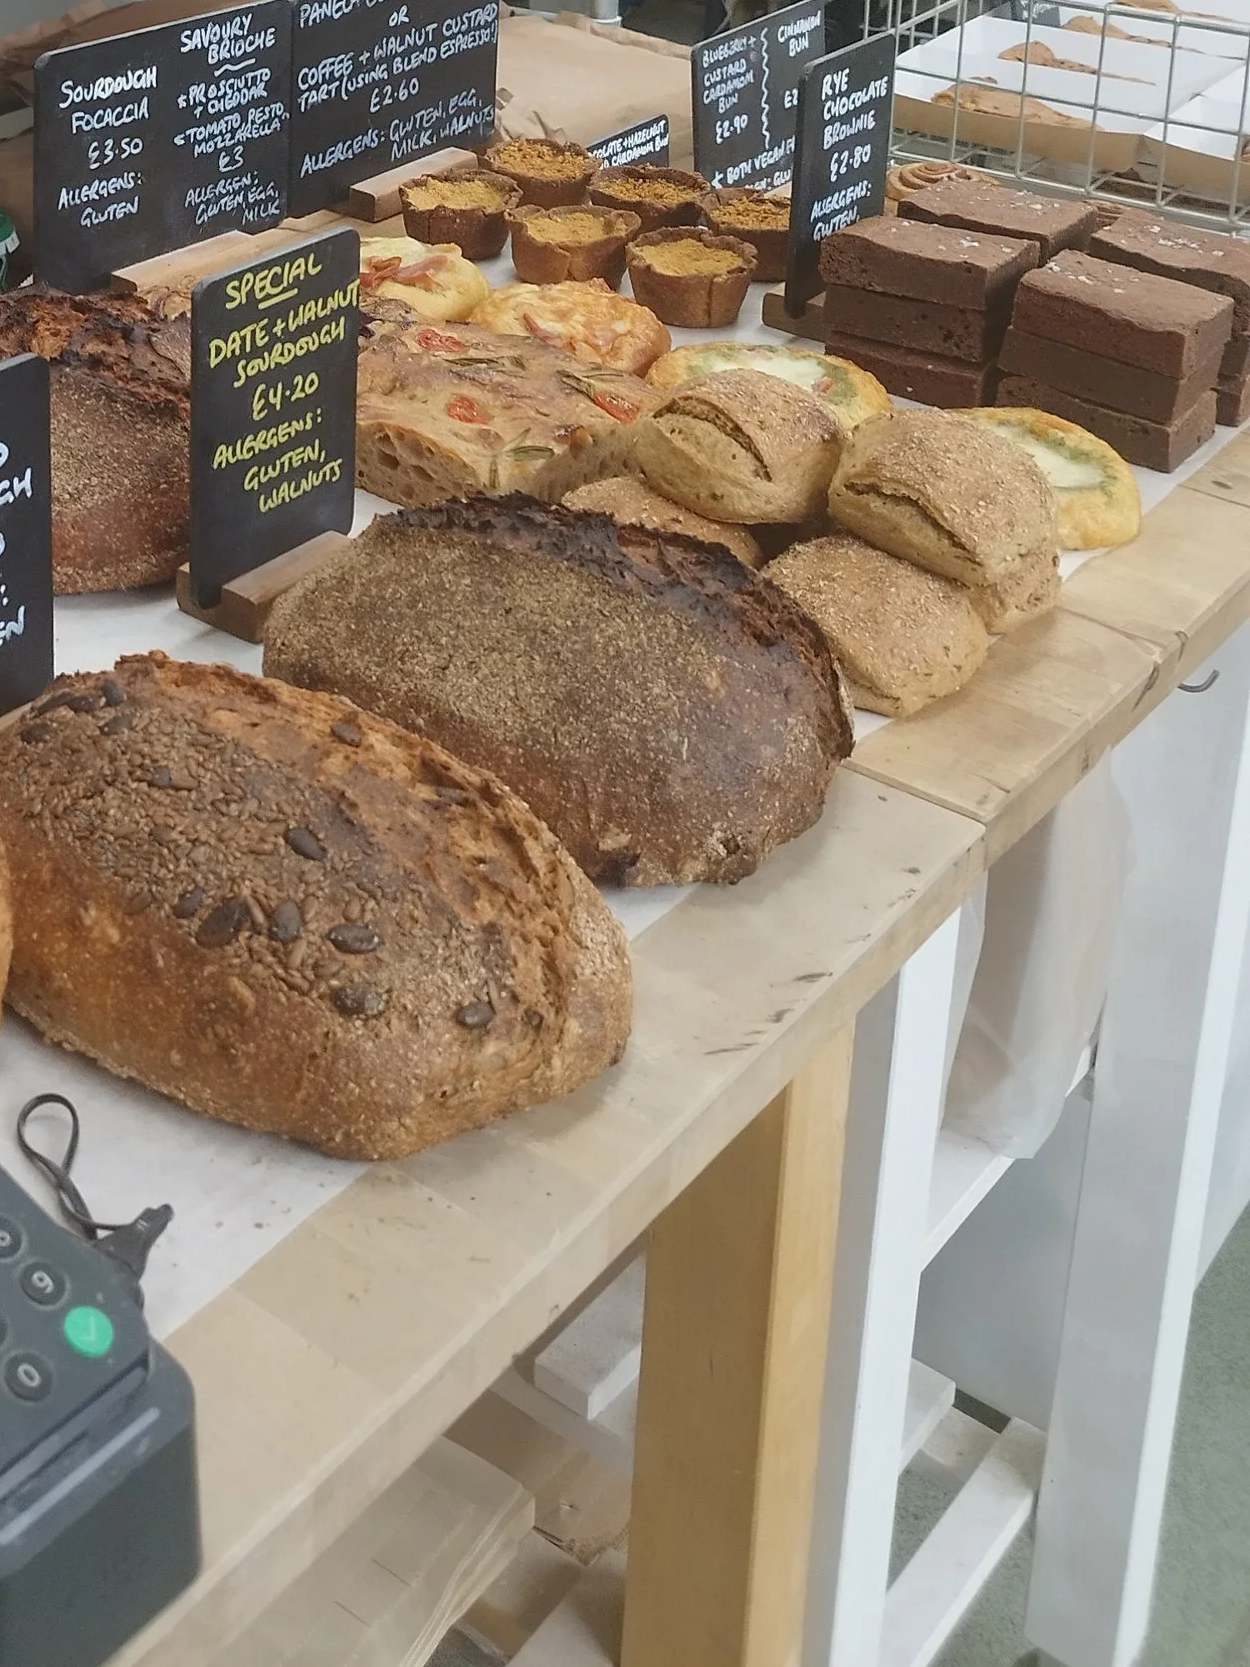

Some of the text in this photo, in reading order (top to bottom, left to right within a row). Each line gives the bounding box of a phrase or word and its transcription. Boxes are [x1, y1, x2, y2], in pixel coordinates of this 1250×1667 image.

[180, 13, 253, 54] SAVOURY
[388, 5, 410, 28] OR
[207, 27, 276, 65] BRIOCHE
[297, 2, 498, 91] COFFEE + WALNUT CUSTARD
[392, 45, 437, 75] BLEND
[789, 32, 809, 57] BUN
[58, 65, 158, 109] SOURDOUGH
[188, 67, 271, 107] PROSCIUTTO
[703, 58, 747, 88] CUSTARD
[821, 67, 850, 101] RYE
[207, 81, 268, 115] CHEDDAR
[369, 77, 419, 114] £2.60
[718, 92, 739, 114] BUN
[823, 76, 889, 121] CHOCOLATE
[71, 97, 149, 134] FOCACCIA
[440, 103, 495, 140] WALNUTS
[715, 114, 748, 145] £2.90
[823, 109, 876, 150] BROWNIE
[87, 137, 144, 170] £3.50
[194, 117, 281, 158] MOZZARELLA
[300, 126, 386, 179] ALLERGENS:
[389, 100, 447, 143] GLUTEN,
[218, 145, 244, 173] £3
[726, 159, 752, 185] BOTH
[754, 139, 785, 171] VEGAN
[830, 143, 872, 183] £2.80
[57, 172, 143, 210] ALLERGENS:
[184, 170, 259, 209] ALLERGEN:
[79, 195, 139, 228] GLUTEN
[241, 199, 281, 225] MILK
[225, 252, 323, 310] SPECIAL
[208, 277, 360, 370] DATE + WALNUT
[233, 316, 347, 389] SOURDOUGH
[251, 371, 320, 422] £4.20
[211, 408, 322, 470] ALLERGENS:
[243, 438, 326, 493] GLUTEN,
[257, 458, 344, 515] WALNUTS
[30, 1269, 54, 1294] 9
[16, 1361, 42, 1388] 0
